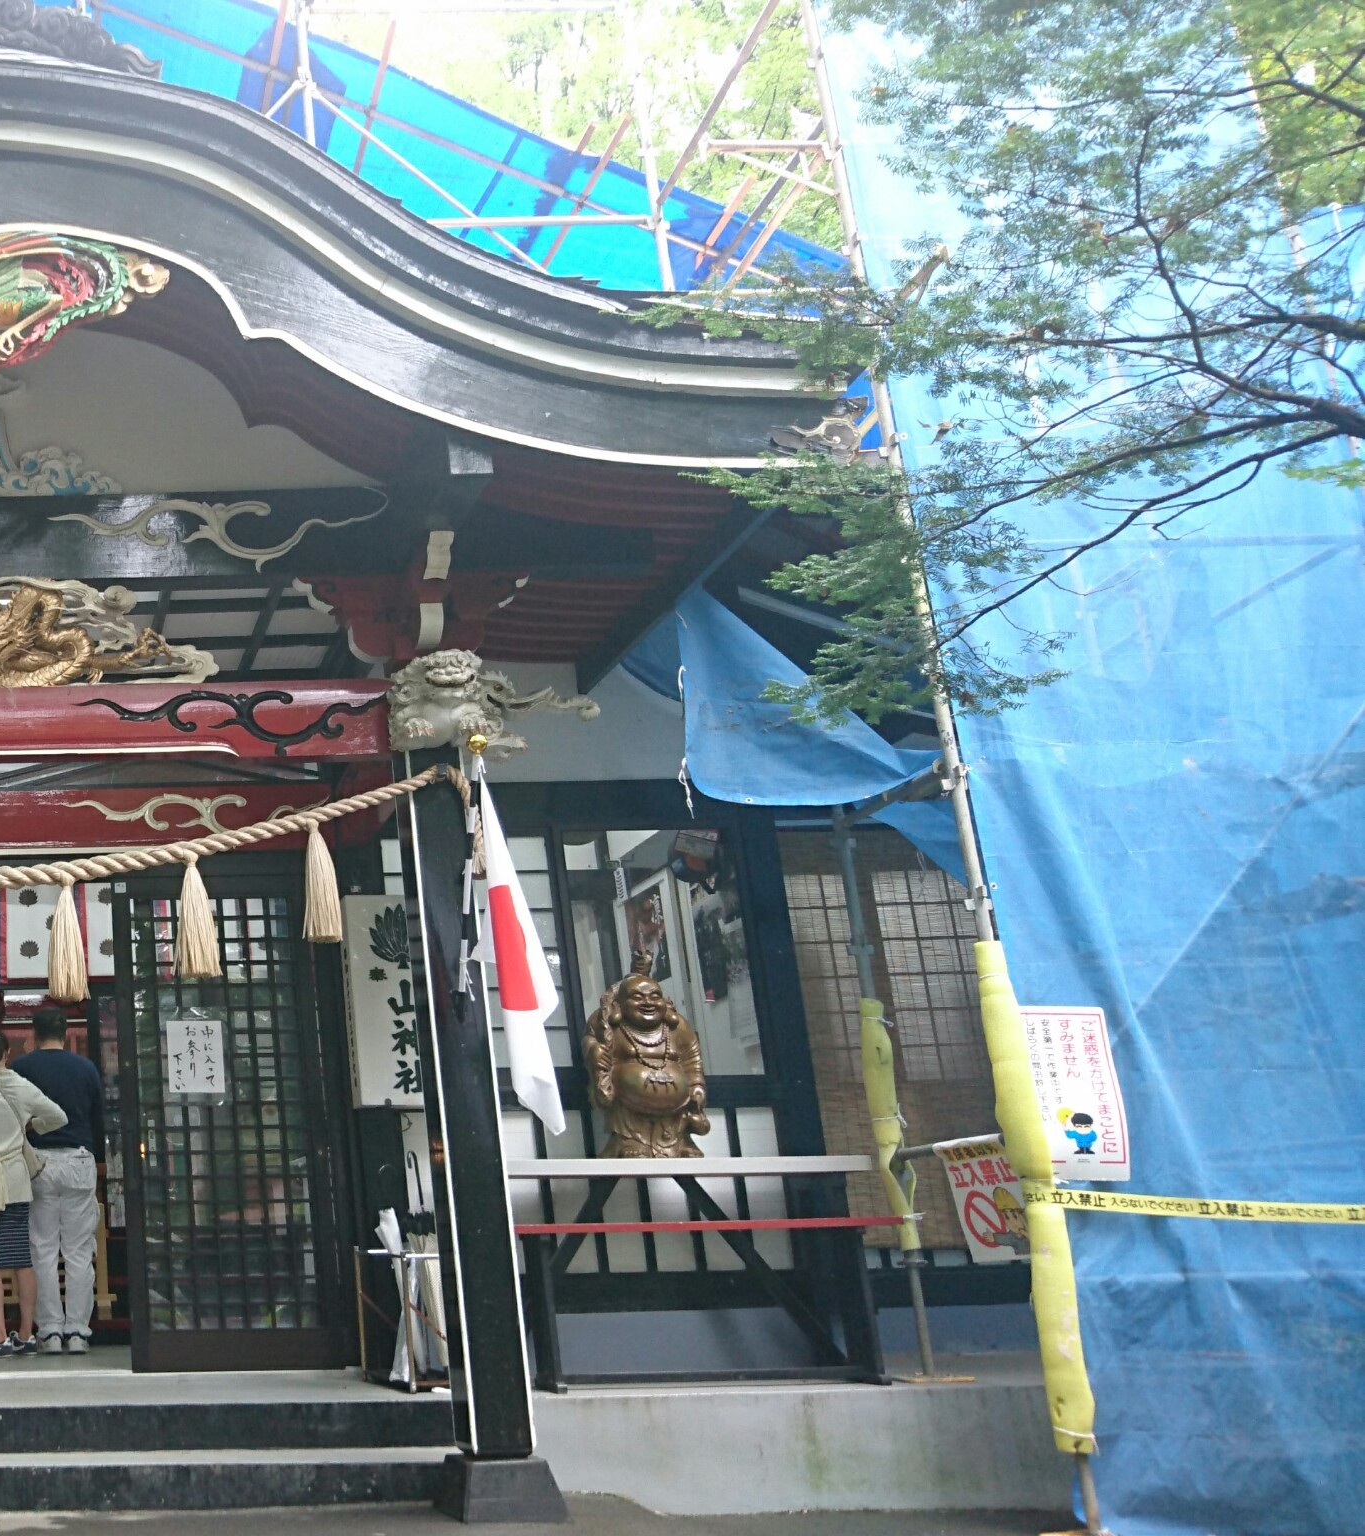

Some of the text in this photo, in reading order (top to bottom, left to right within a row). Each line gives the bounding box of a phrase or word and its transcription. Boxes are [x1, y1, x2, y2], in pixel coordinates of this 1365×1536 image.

[369, 966, 387, 983] 奉
[185, 1025, 200, 1078] お参り
[201, 1025, 216, 1087] 中に入って
[173, 1052, 185, 1090] 下さい
[948, 1157, 1019, 1188] 立入禁止
[1051, 1191, 1106, 1208] 立入禁止
[1111, 1196, 1194, 1212] 入らないでください
[1198, 1202, 1254, 1217] 立入禁止
[1347, 1207, 1365, 1221] 立
